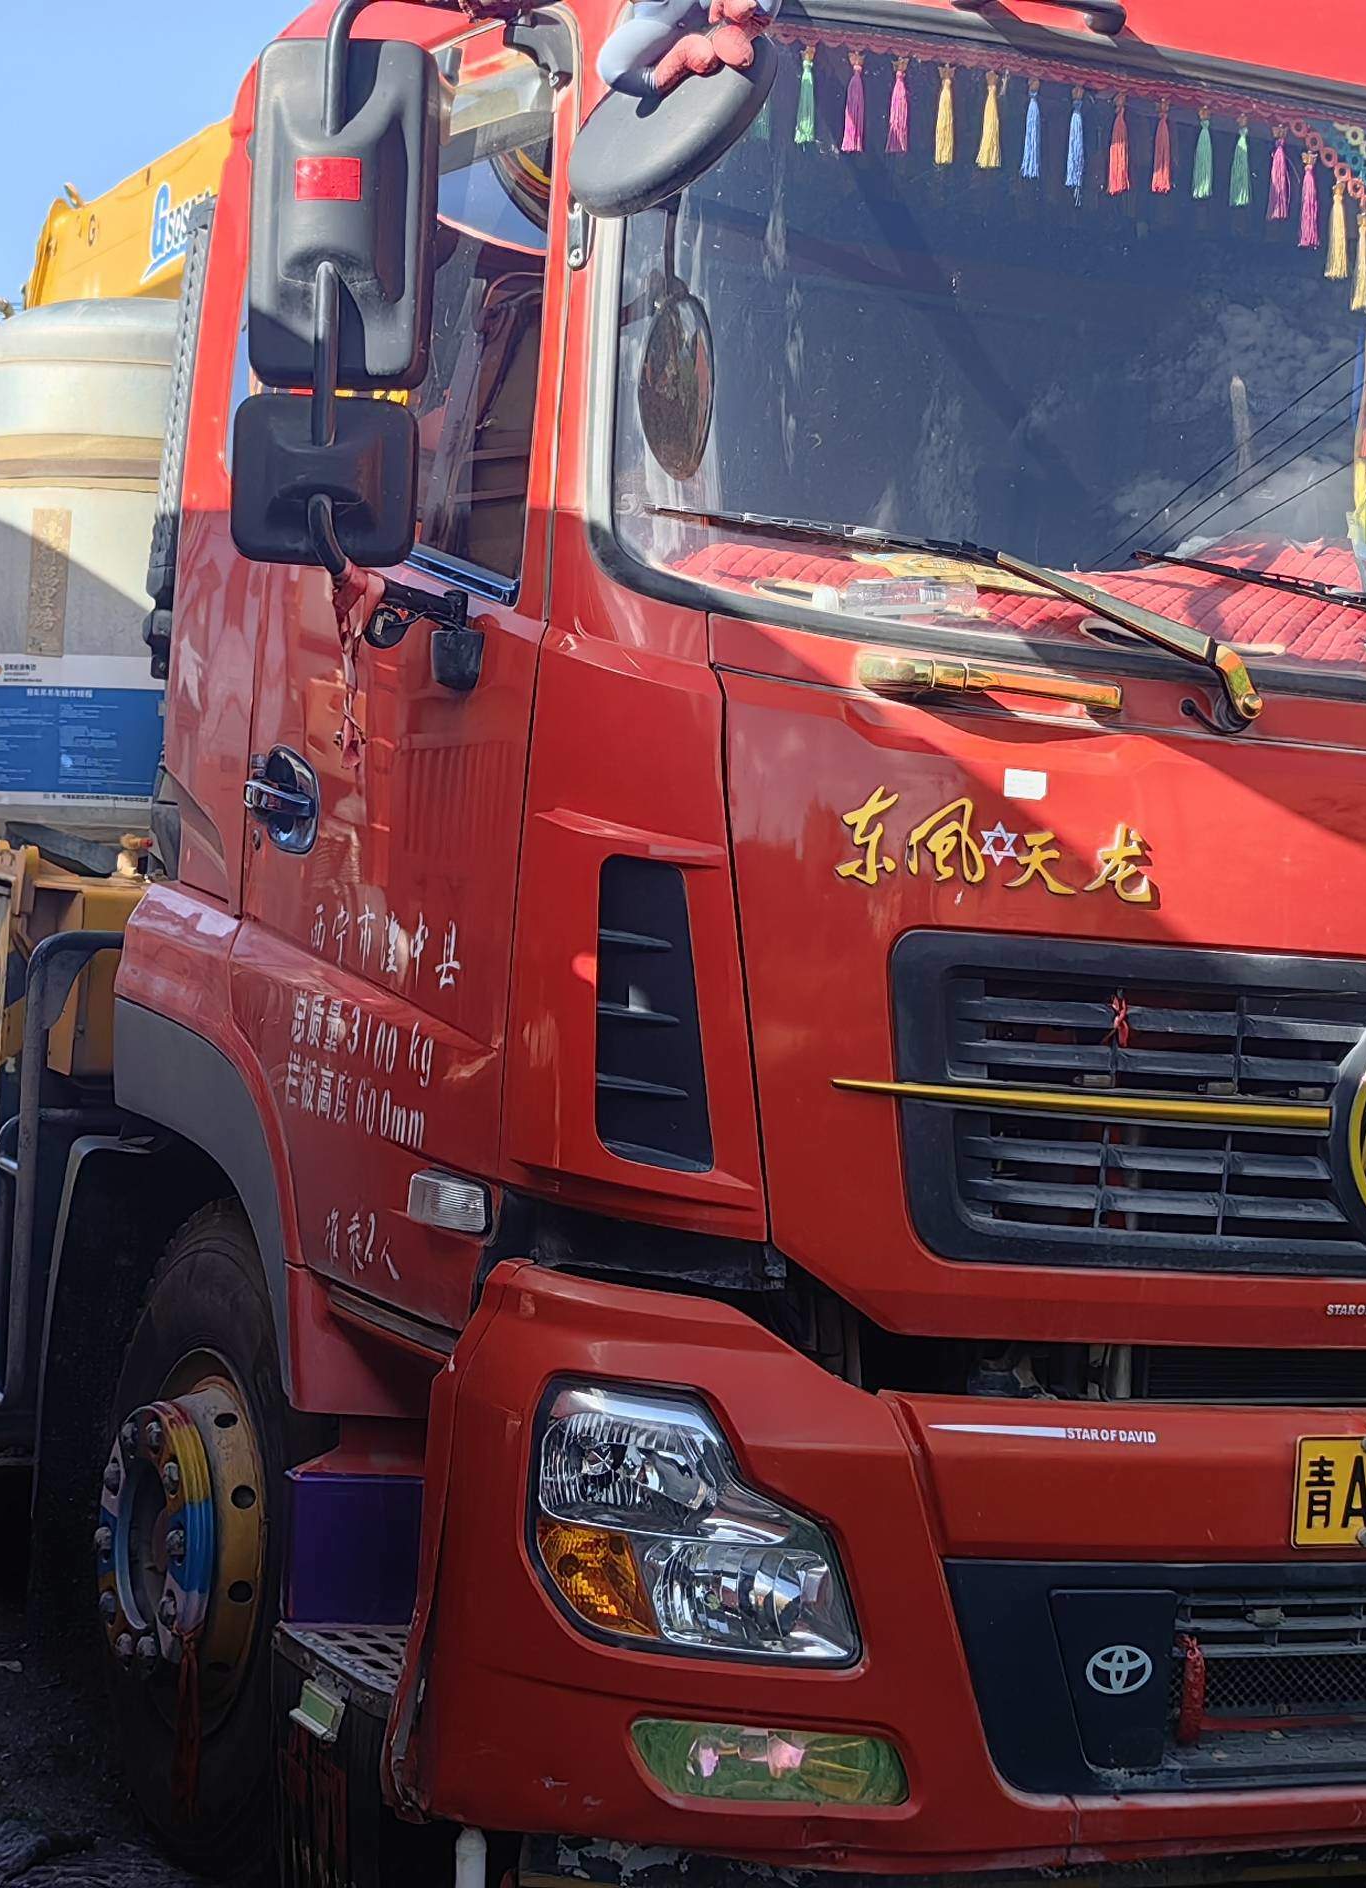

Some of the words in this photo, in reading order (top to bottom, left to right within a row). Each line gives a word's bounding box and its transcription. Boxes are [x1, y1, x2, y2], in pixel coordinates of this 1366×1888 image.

[310, 903, 461, 990] 西宁市湟中县
[408, 1021, 434, 1088] kg
[1326, 1304, 1356, 1315] STAR
[1066, 1427, 1100, 1441] STAR
[1100, 1430, 1116, 1442] OF
[1119, 1431, 1157, 1443] DAVID
